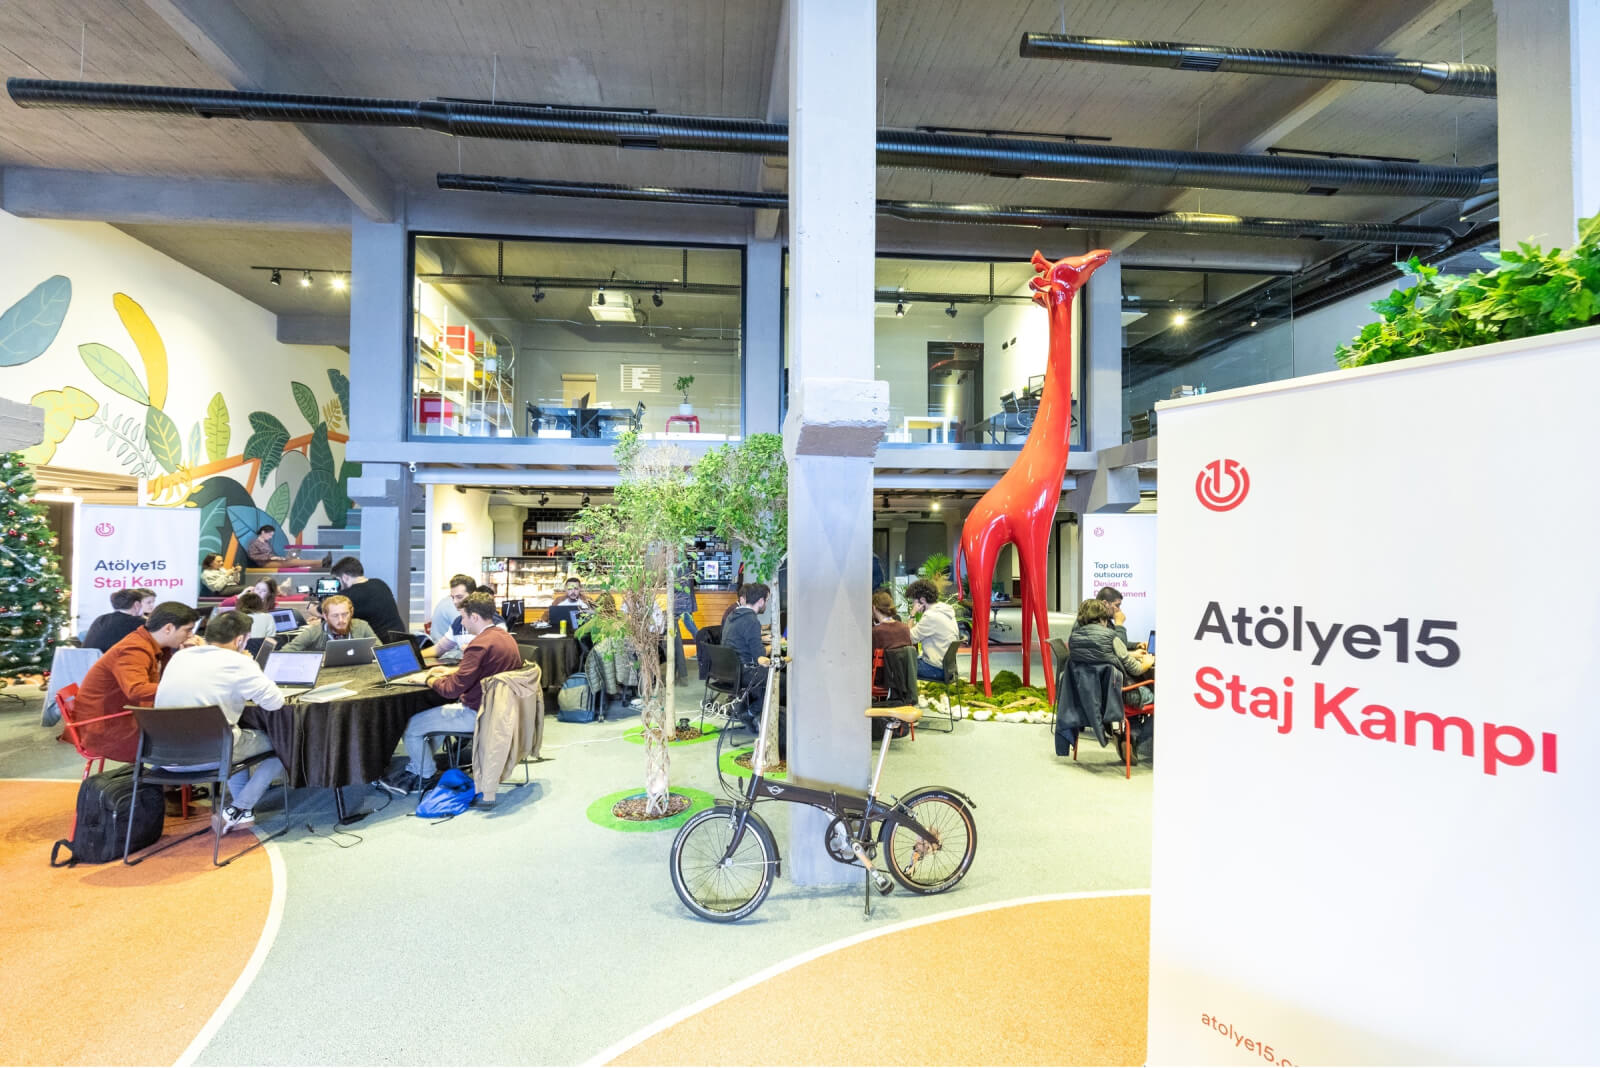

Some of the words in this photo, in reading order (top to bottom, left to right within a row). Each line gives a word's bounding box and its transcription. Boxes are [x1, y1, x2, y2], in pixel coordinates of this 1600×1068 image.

[94, 560, 167, 573] Atölye15
[1094, 562, 1109, 570] Top
[94, 577, 127, 589] Staj
[132, 577, 184, 589] Kampı
[1193, 600, 1462, 668] Atölye15
[1193, 666, 1295, 735] Staj
[1314, 682, 1558, 777] Kampı
